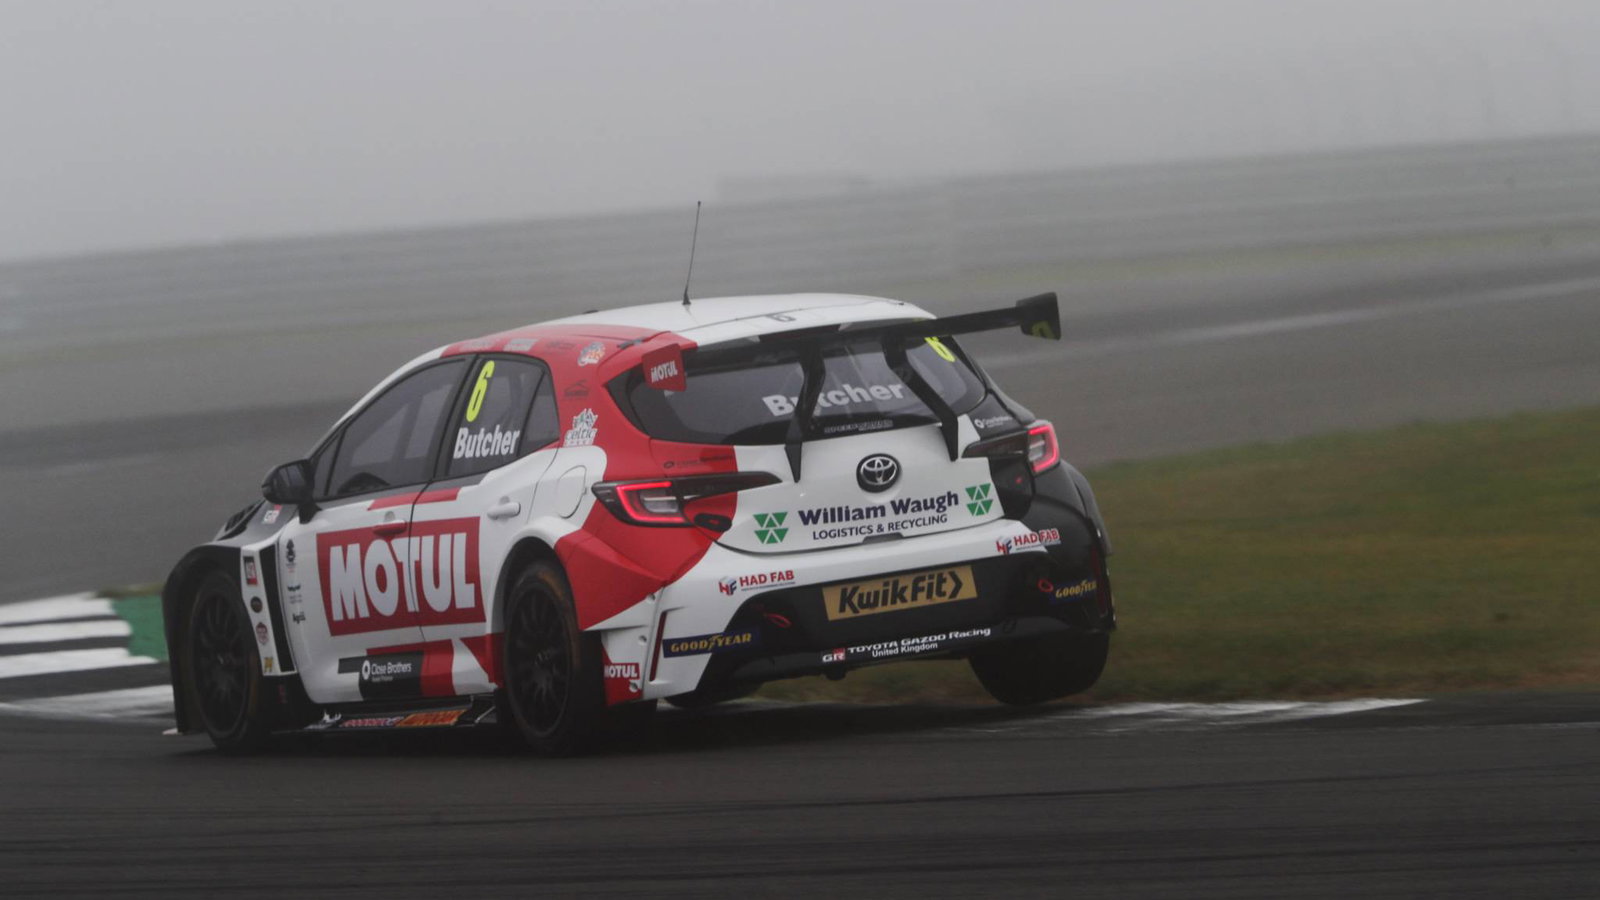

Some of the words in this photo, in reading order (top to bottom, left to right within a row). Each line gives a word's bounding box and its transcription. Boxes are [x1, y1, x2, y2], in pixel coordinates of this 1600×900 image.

[650, 360, 679, 383] MOTUL
[466, 360, 495, 422] 6
[761, 383, 904, 417] Btcher
[453, 424, 520, 459] Butcher
[798, 504, 886, 526] William
[890, 491, 959, 515] Waugh
[812, 525, 874, 540] LOGISTICS
[876, 523, 885, 533] &
[887, 513, 948, 532] RECYCLING
[1013, 531, 1039, 546] HAD
[1039, 528, 1060, 543] FAB
[330, 532, 476, 621] MOTUL
[738, 573, 767, 587] HAD
[770, 569, 795, 583] FAB
[670, 632, 752, 652] GOODYEAR
[848, 640, 898, 654] TOYOTA
[900, 633, 946, 647] GAZOO
[949, 627, 992, 640] Racing
[872, 646, 899, 658] United
[900, 641, 938, 656] Kingdom
[822, 651, 846, 663] GR
